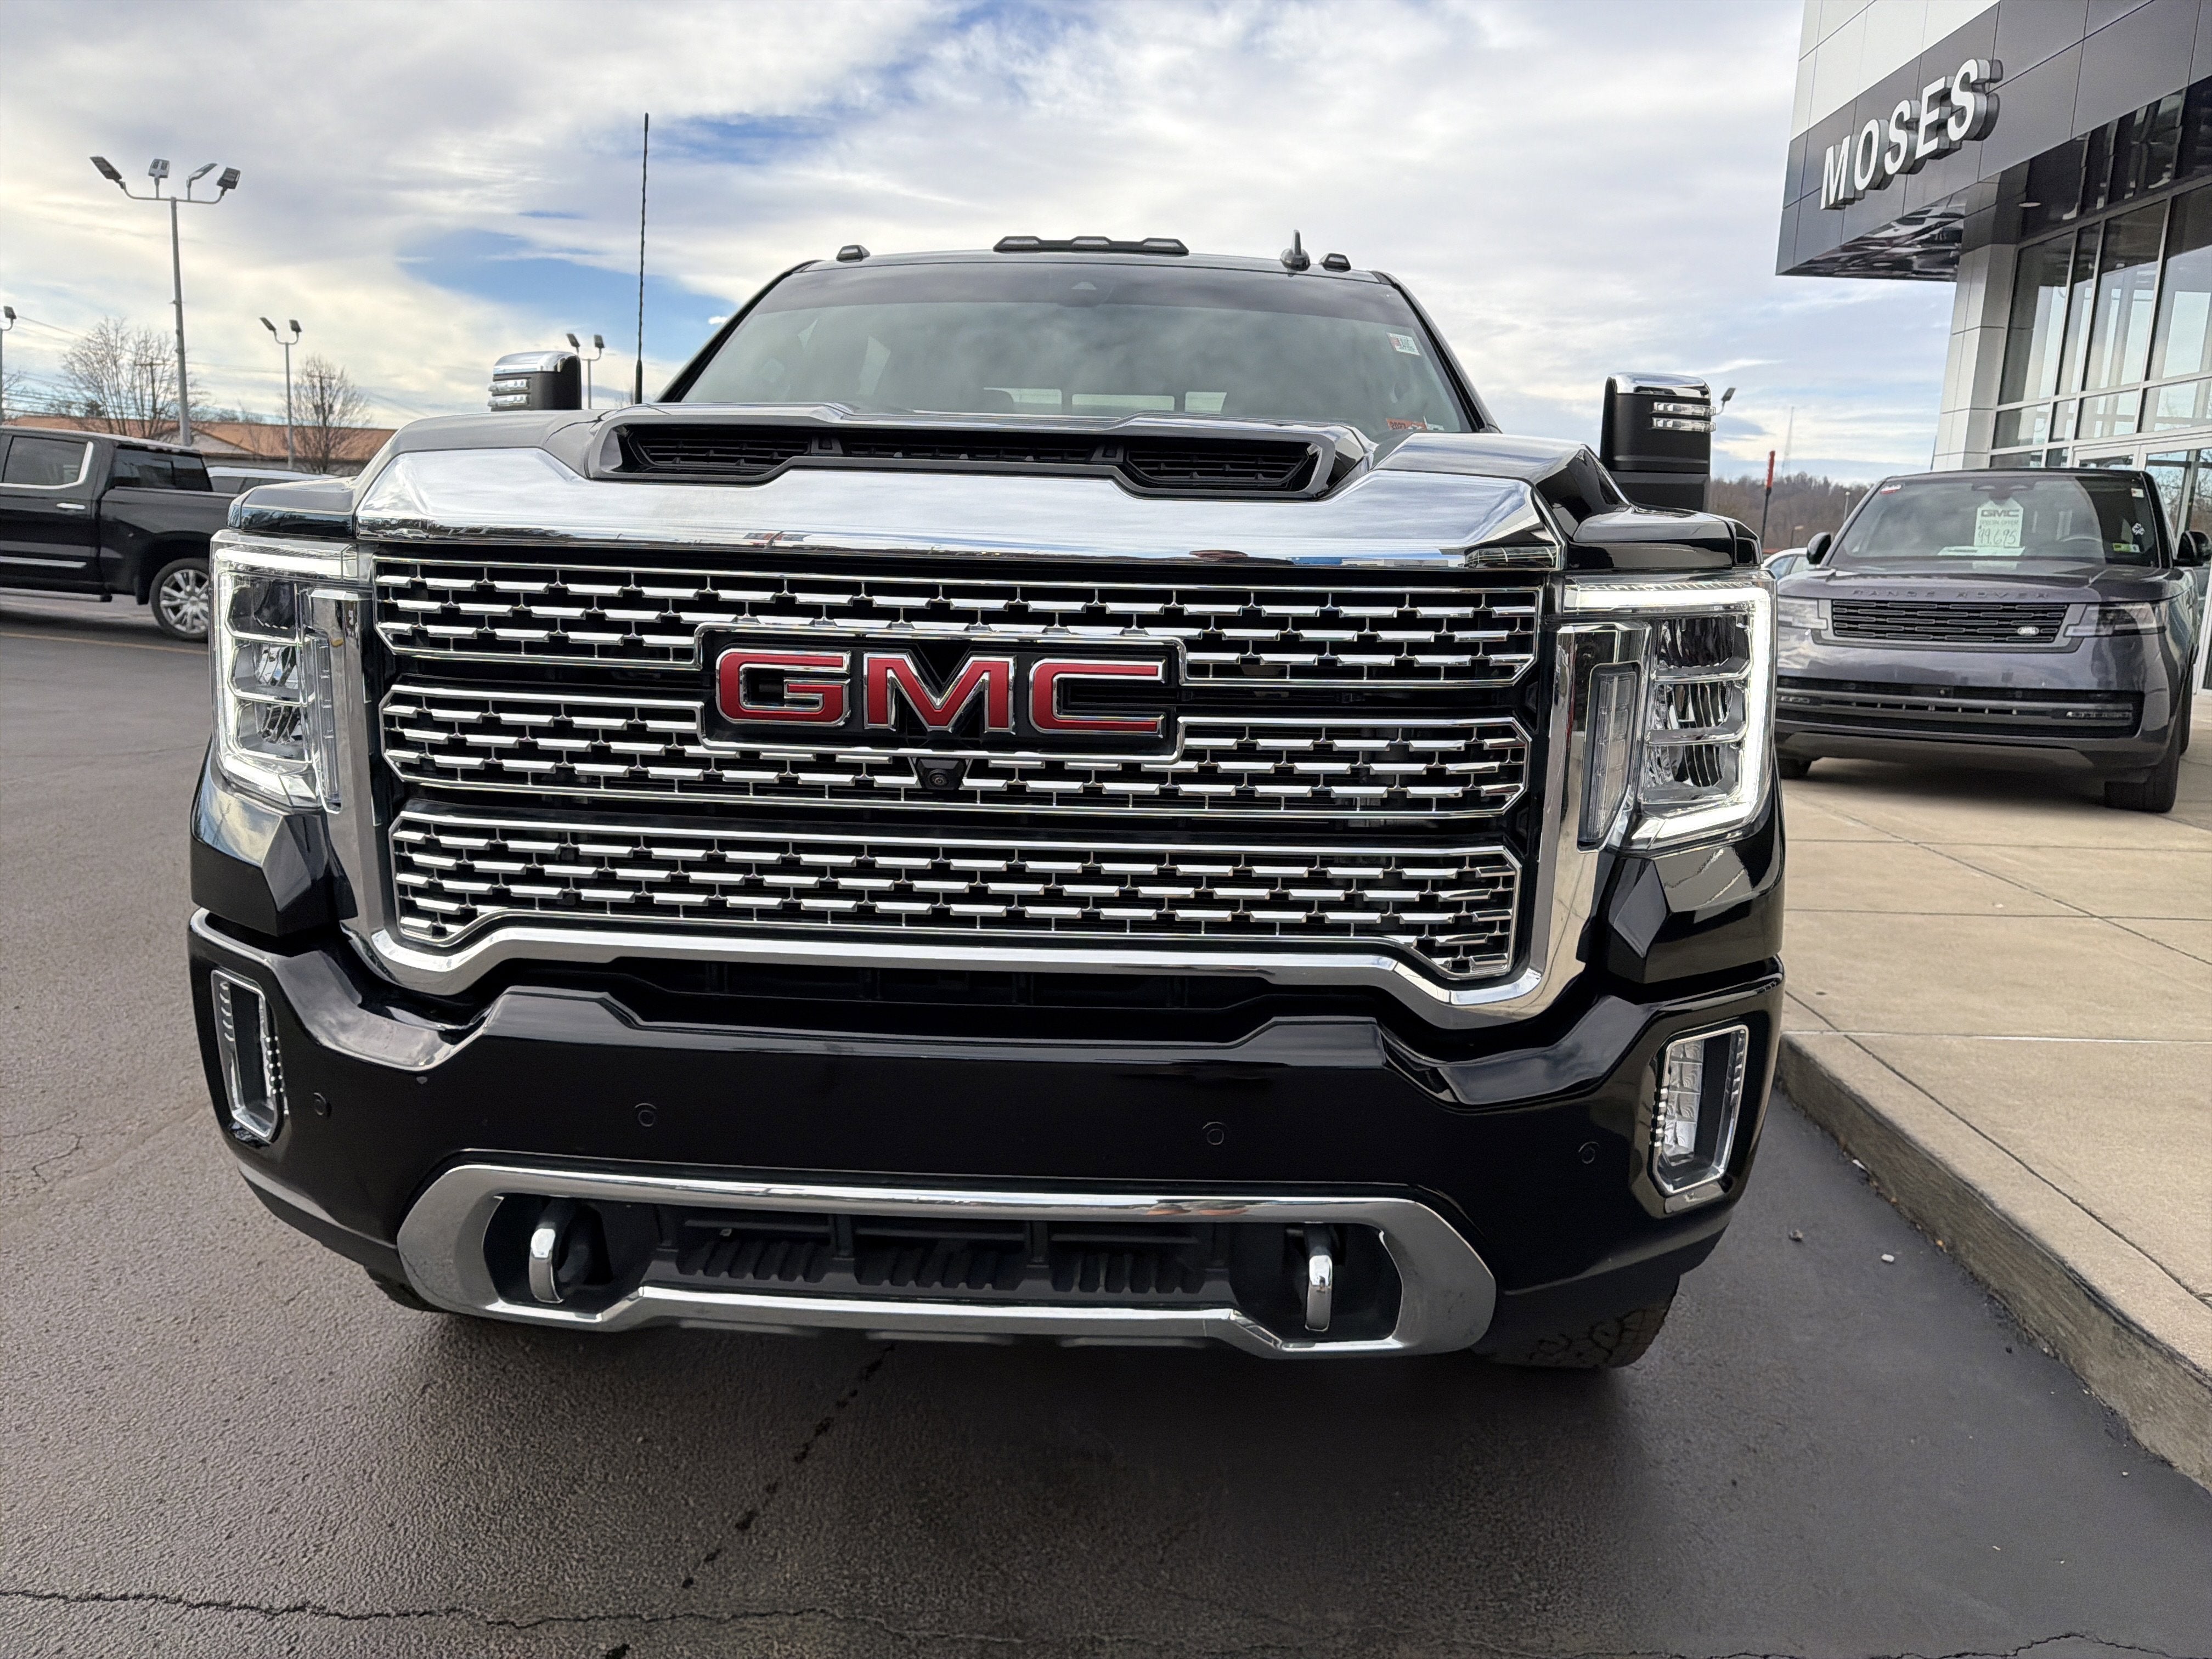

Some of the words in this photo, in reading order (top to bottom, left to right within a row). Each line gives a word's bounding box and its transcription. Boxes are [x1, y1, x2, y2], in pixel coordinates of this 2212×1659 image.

[1820, 59, 1982, 210] MOSES
[1853, 589, 1935, 597] RANGE
[715, 647, 1167, 737] GMC
